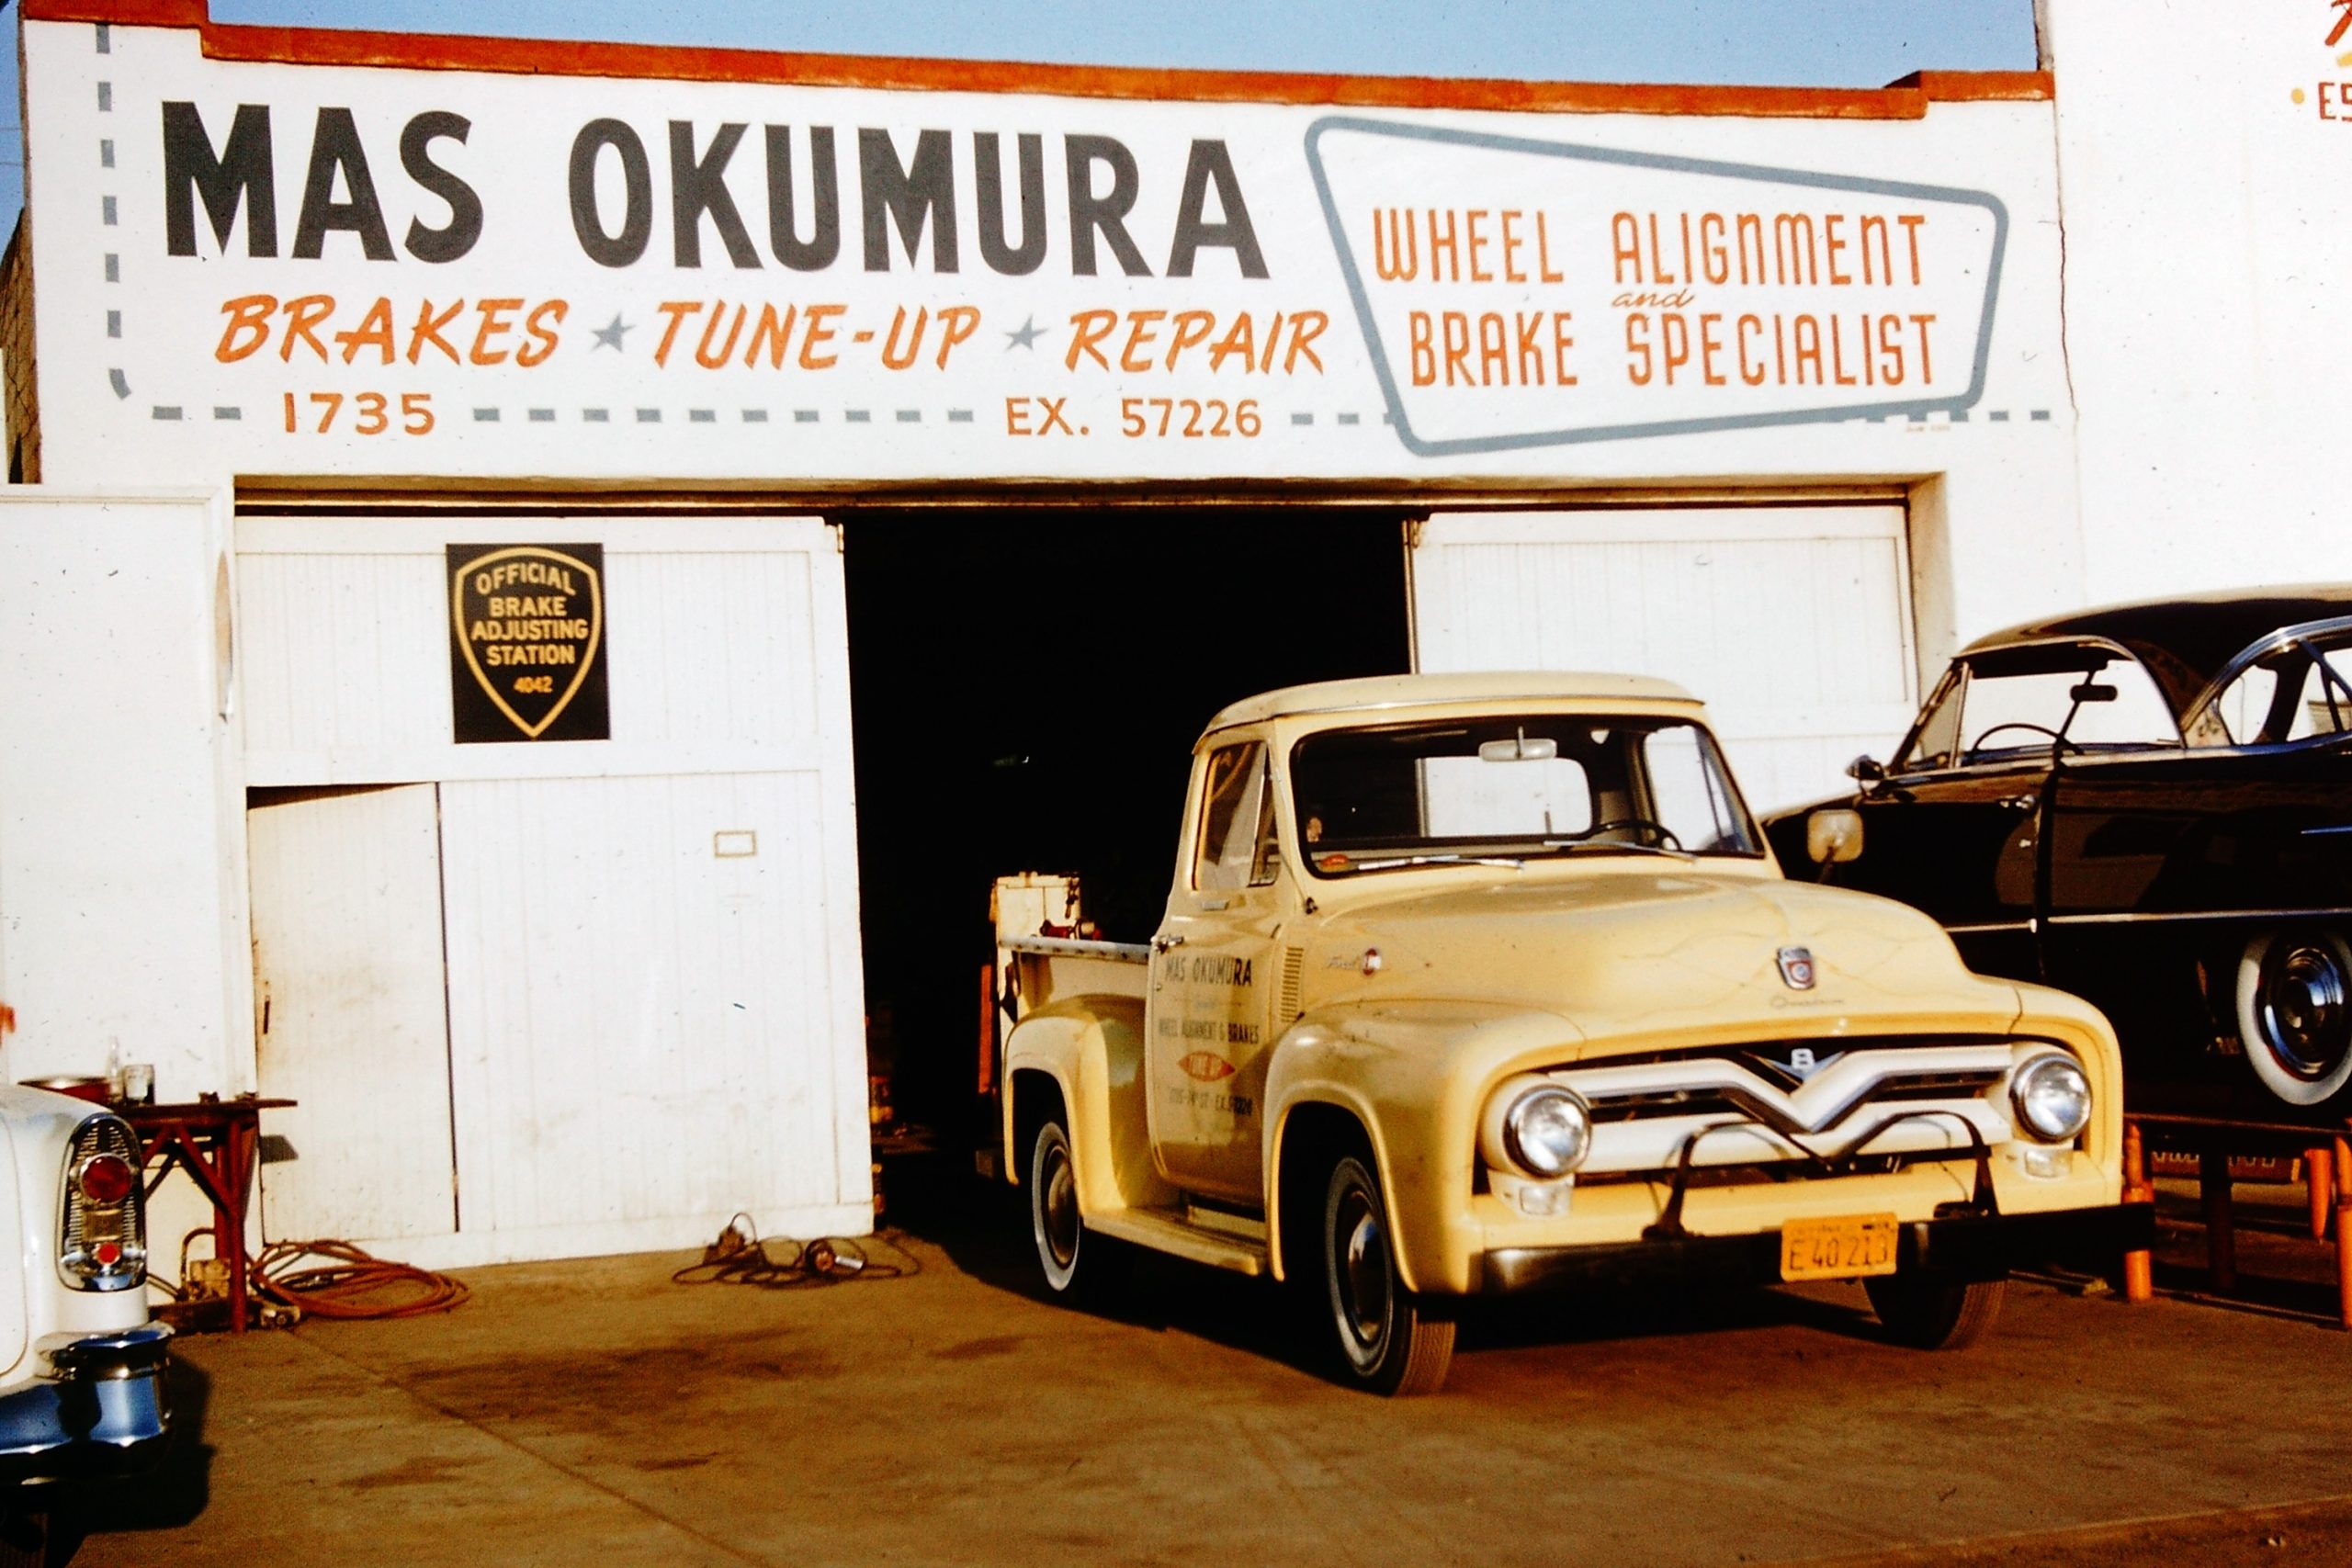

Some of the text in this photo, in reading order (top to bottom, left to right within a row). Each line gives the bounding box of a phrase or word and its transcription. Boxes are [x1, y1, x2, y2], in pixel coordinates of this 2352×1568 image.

[163, 102, 1267, 276] MAS OKUMURA
[1374, 209, 1926, 286] WHEEL ALIGNMENT
[1612, 288, 1695, 309] and
[215, 294, 1329, 374] BRAKES TUNE-UP REPAIR
[1410, 310, 1936, 387] BRAKE SPECIALIST
[284, 391, 435, 435] 1735
[1006, 397, 1262, 438] EX. 57226
[476, 561, 577, 595] OFFICIAL
[489, 596, 567, 617] BRAKE
[470, 619, 589, 641] ADJUSTING
[486, 644, 575, 666] STATION
[513, 675, 554, 694] 4042
[1165, 956, 1252, 986] MAS OKUMURA
[1227, 1022, 1260, 1044] BRAKES
[1789, 1239, 1805, 1270] E
